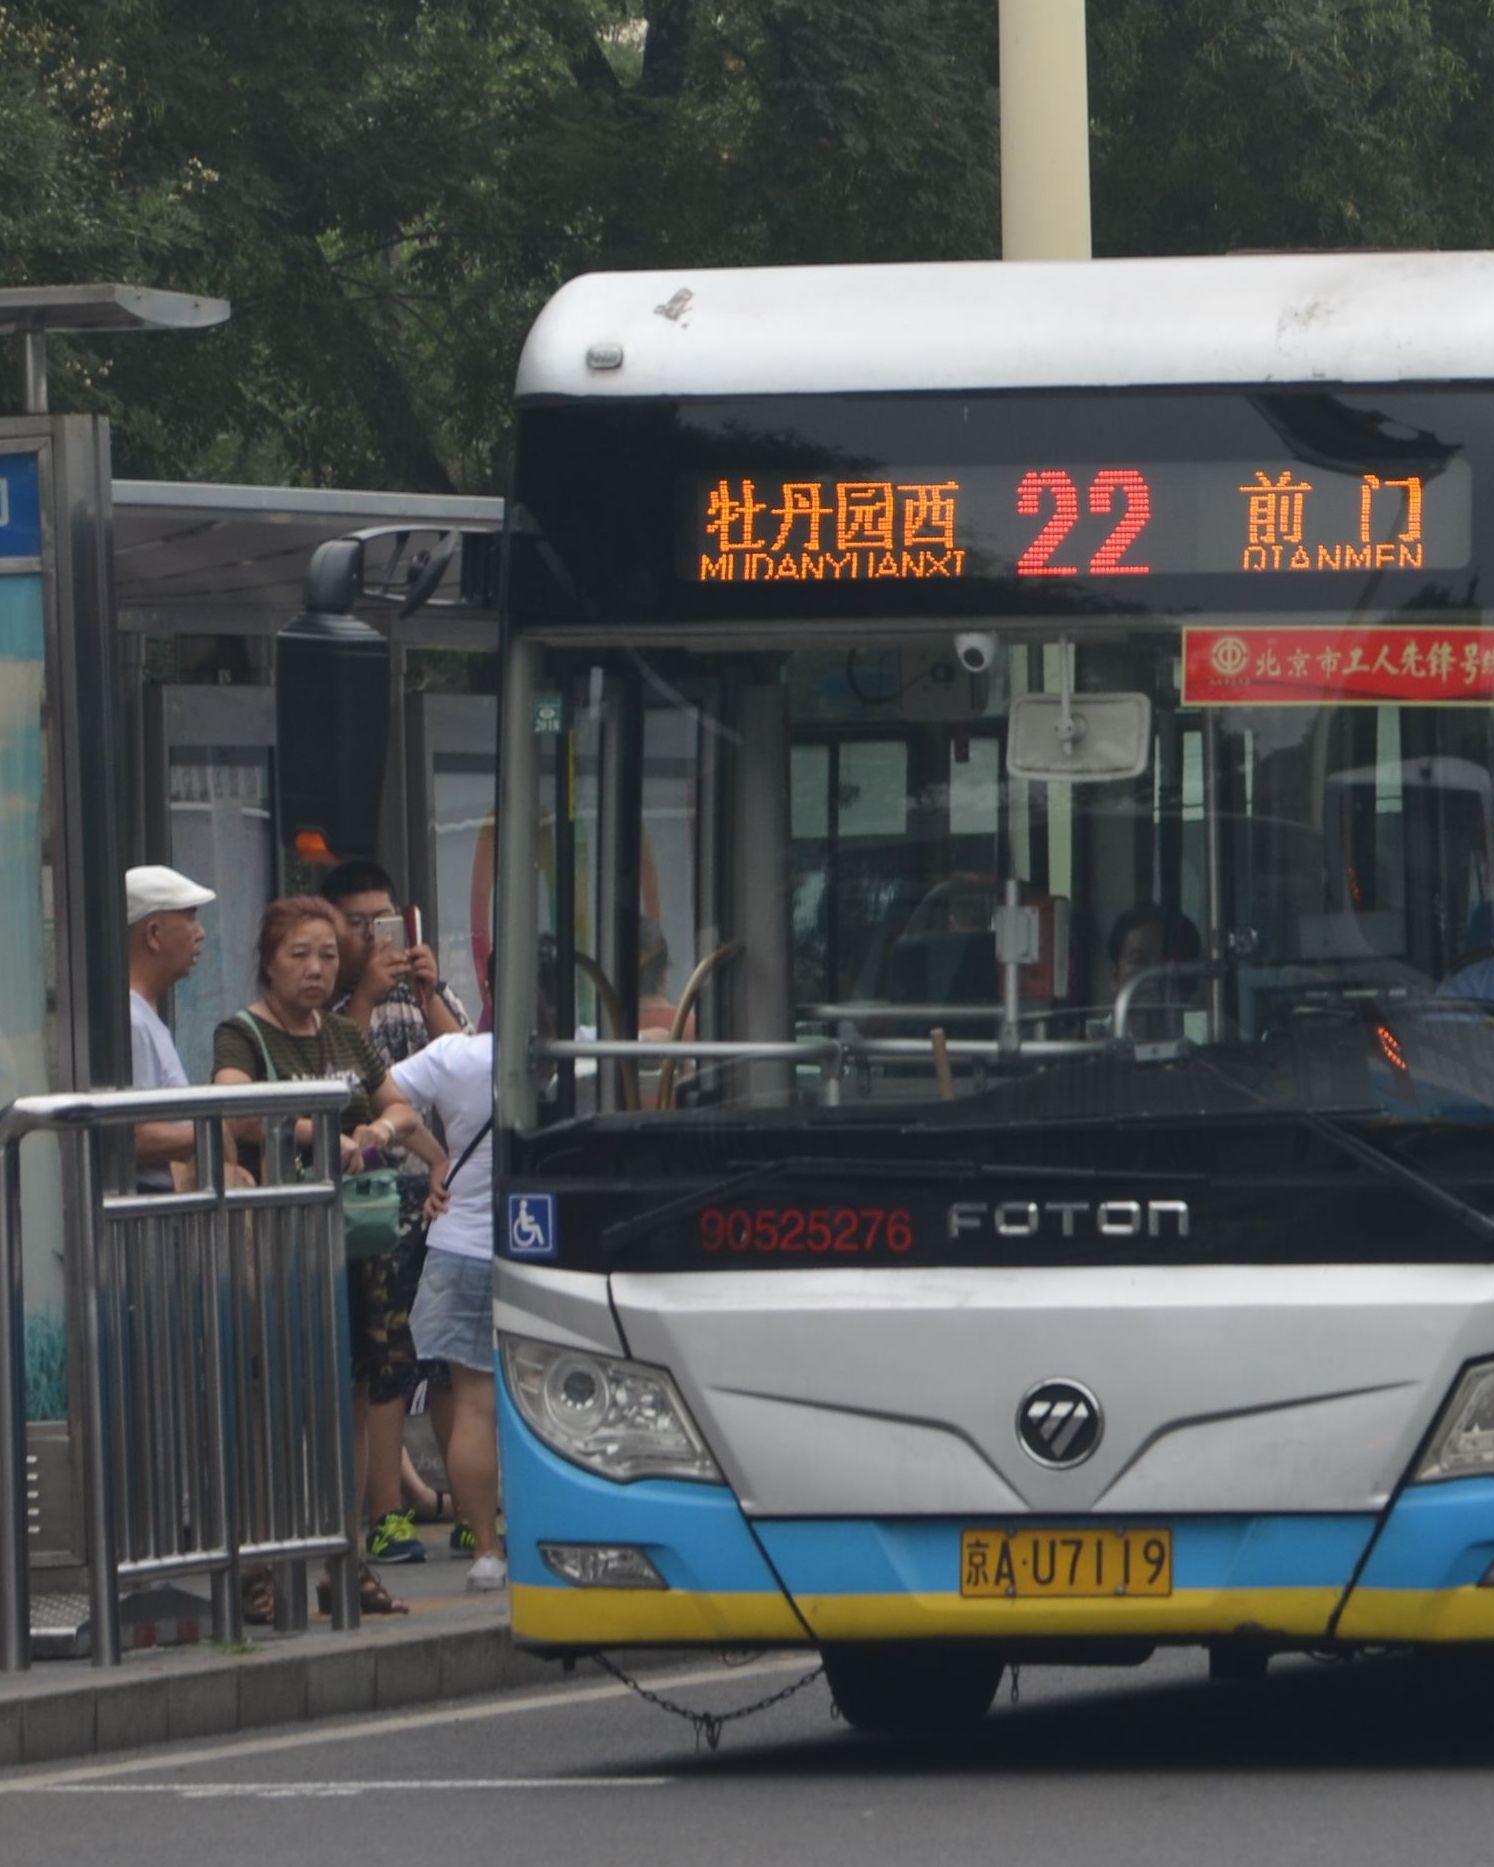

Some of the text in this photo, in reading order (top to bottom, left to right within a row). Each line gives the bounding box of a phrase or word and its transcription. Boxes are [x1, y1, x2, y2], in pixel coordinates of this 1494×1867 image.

[706, 479, 959, 551] 牡丹园西
[1016, 469, 1151, 577] 22
[701, 1206, 914, 1253] 90525276
[949, 1201, 1190, 1237] FOTON
